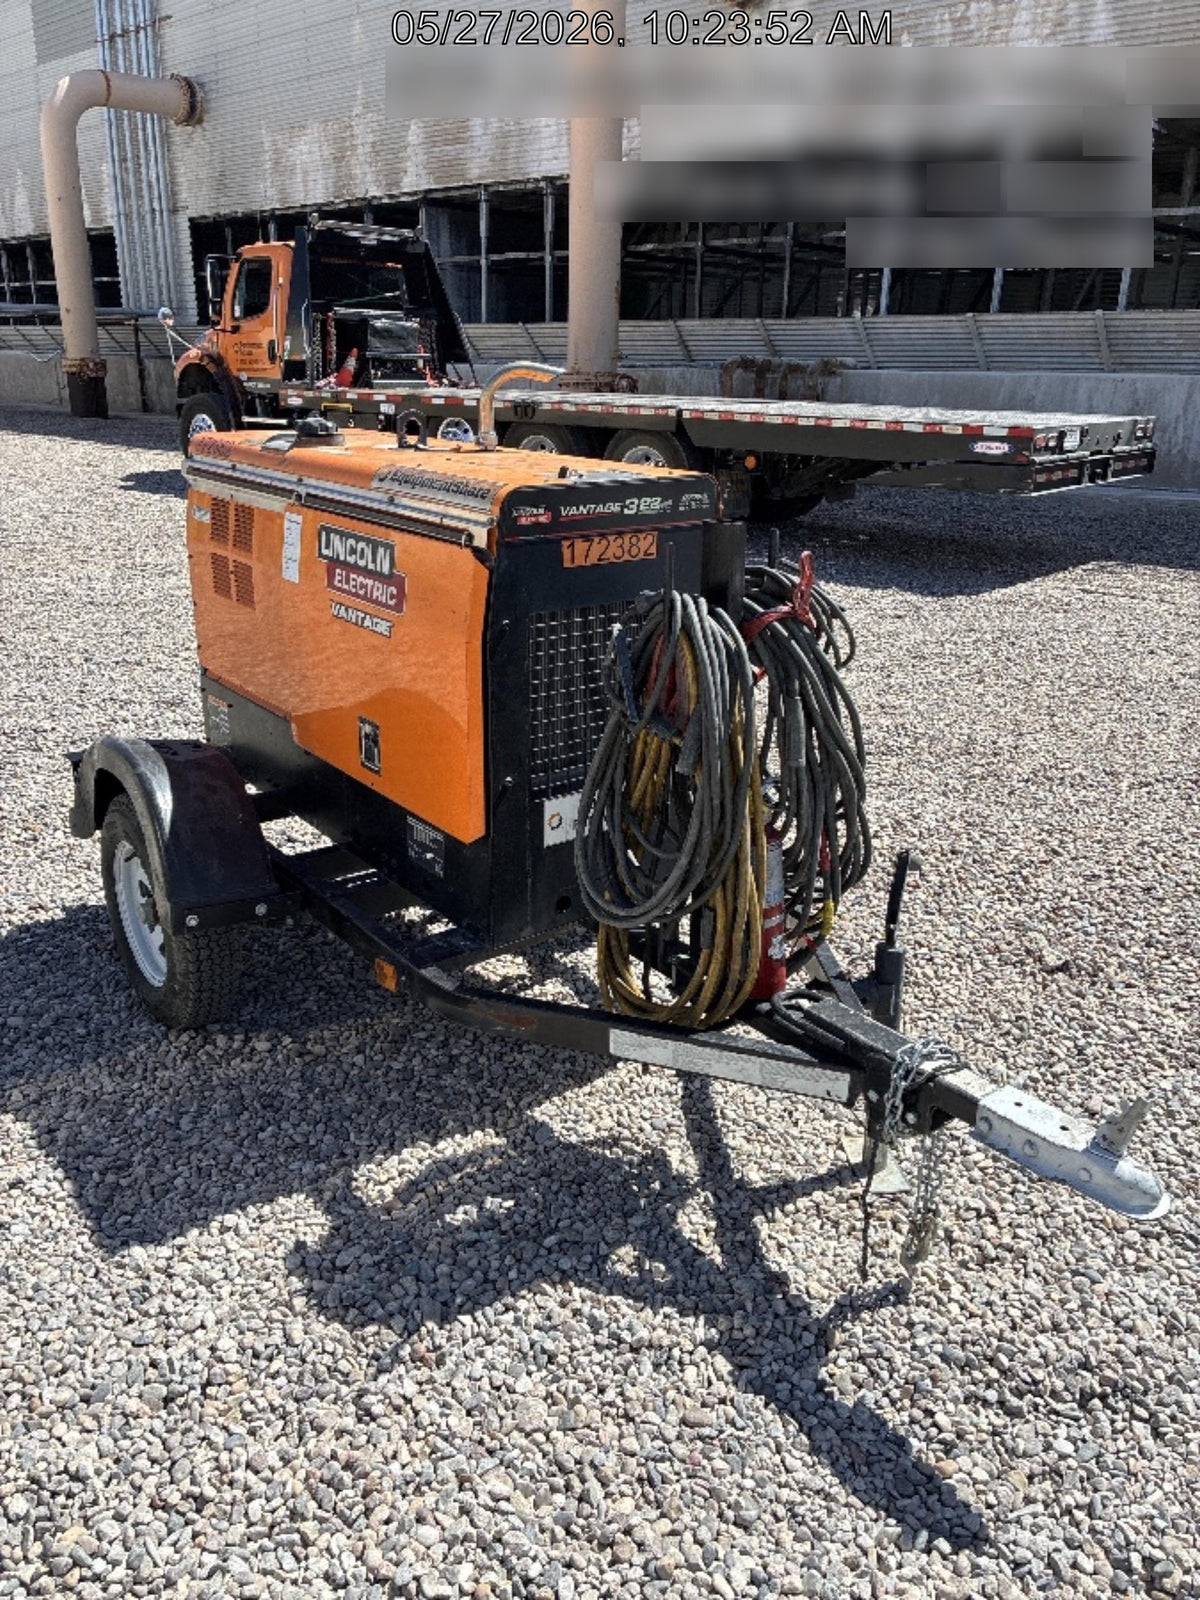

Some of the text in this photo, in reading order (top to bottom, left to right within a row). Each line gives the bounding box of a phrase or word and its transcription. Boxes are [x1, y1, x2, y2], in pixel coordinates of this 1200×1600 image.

[560, 502, 624, 517] VANTAGE
[321, 530, 391, 576] LINCOLN
[566, 533, 656, 565] 172382
[333, 567, 398, 606] ELECTRIC
[331, 601, 394, 638] VANTAGE
